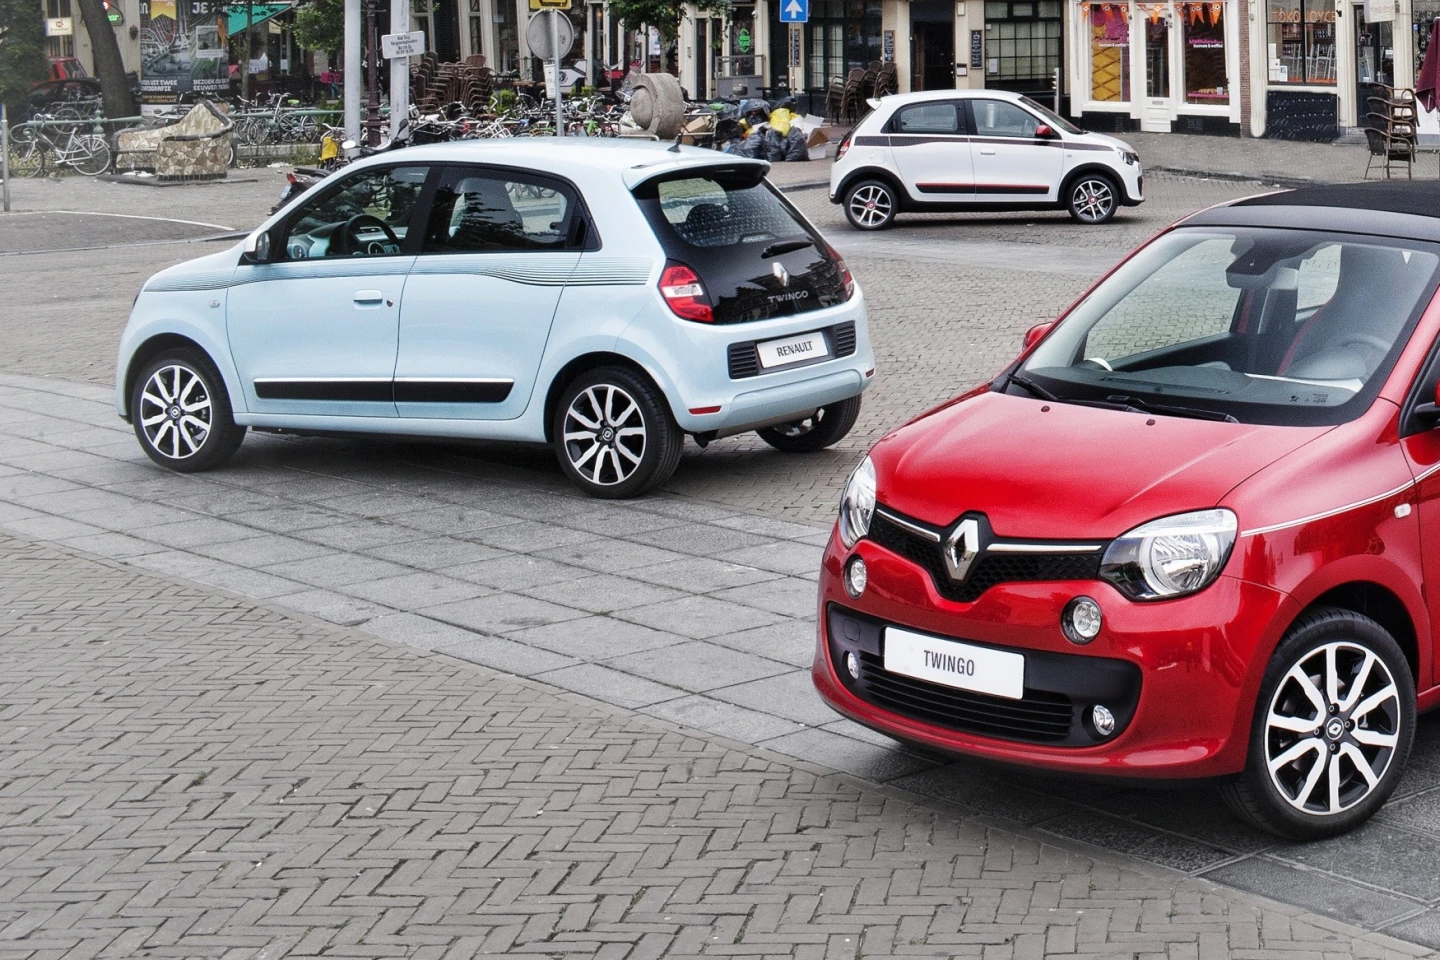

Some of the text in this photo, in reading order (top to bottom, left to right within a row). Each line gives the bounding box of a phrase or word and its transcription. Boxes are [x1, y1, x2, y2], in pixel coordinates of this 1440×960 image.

[767, 290, 809, 303] TWINGO
[776, 340, 813, 357] RENAULT
[923, 650, 975, 677] TWINGO
